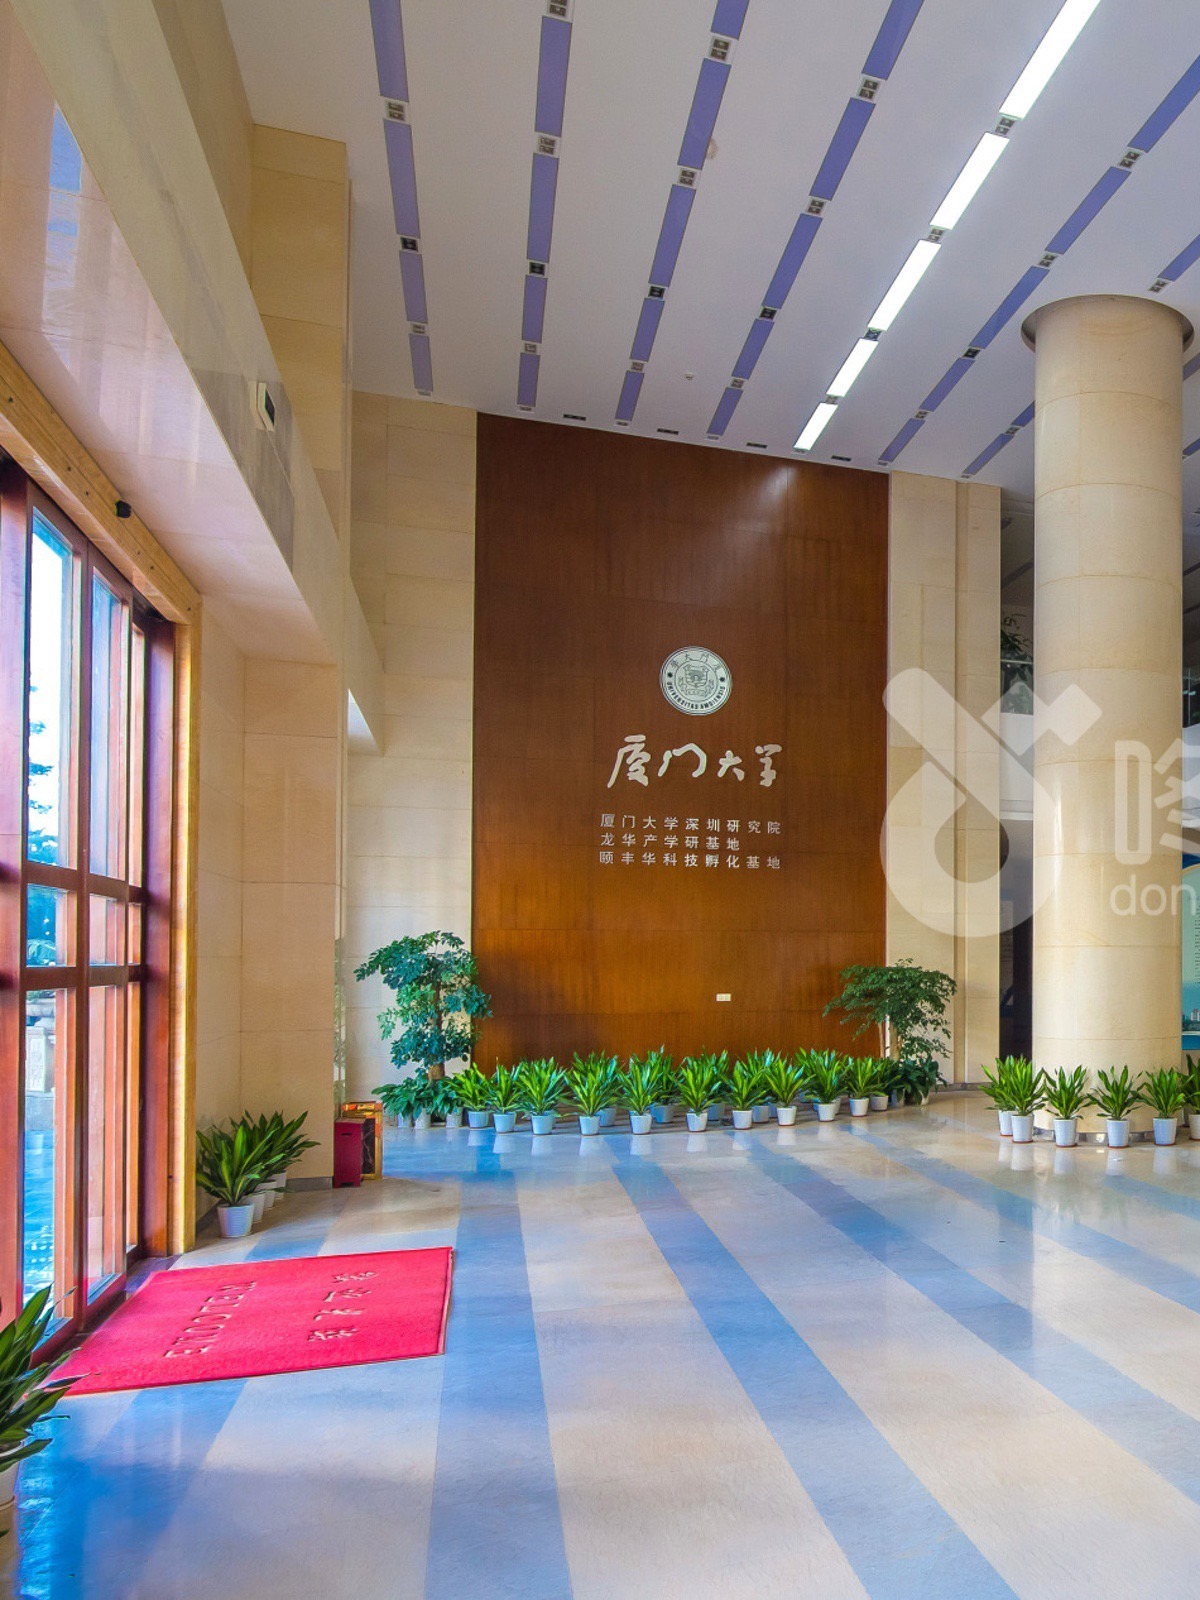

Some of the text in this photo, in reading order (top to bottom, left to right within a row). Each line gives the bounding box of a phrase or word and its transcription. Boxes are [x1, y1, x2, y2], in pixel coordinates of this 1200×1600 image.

[607, 734, 783, 789] 厦门大学
[600, 813, 782, 834] 厦门大学深圳研究院
[600, 833, 741, 852] 龙华产学研基地
[599, 851, 782, 869] 颐丰华科技孵化基地
[164, 1281, 257, 1358] WELCOME
